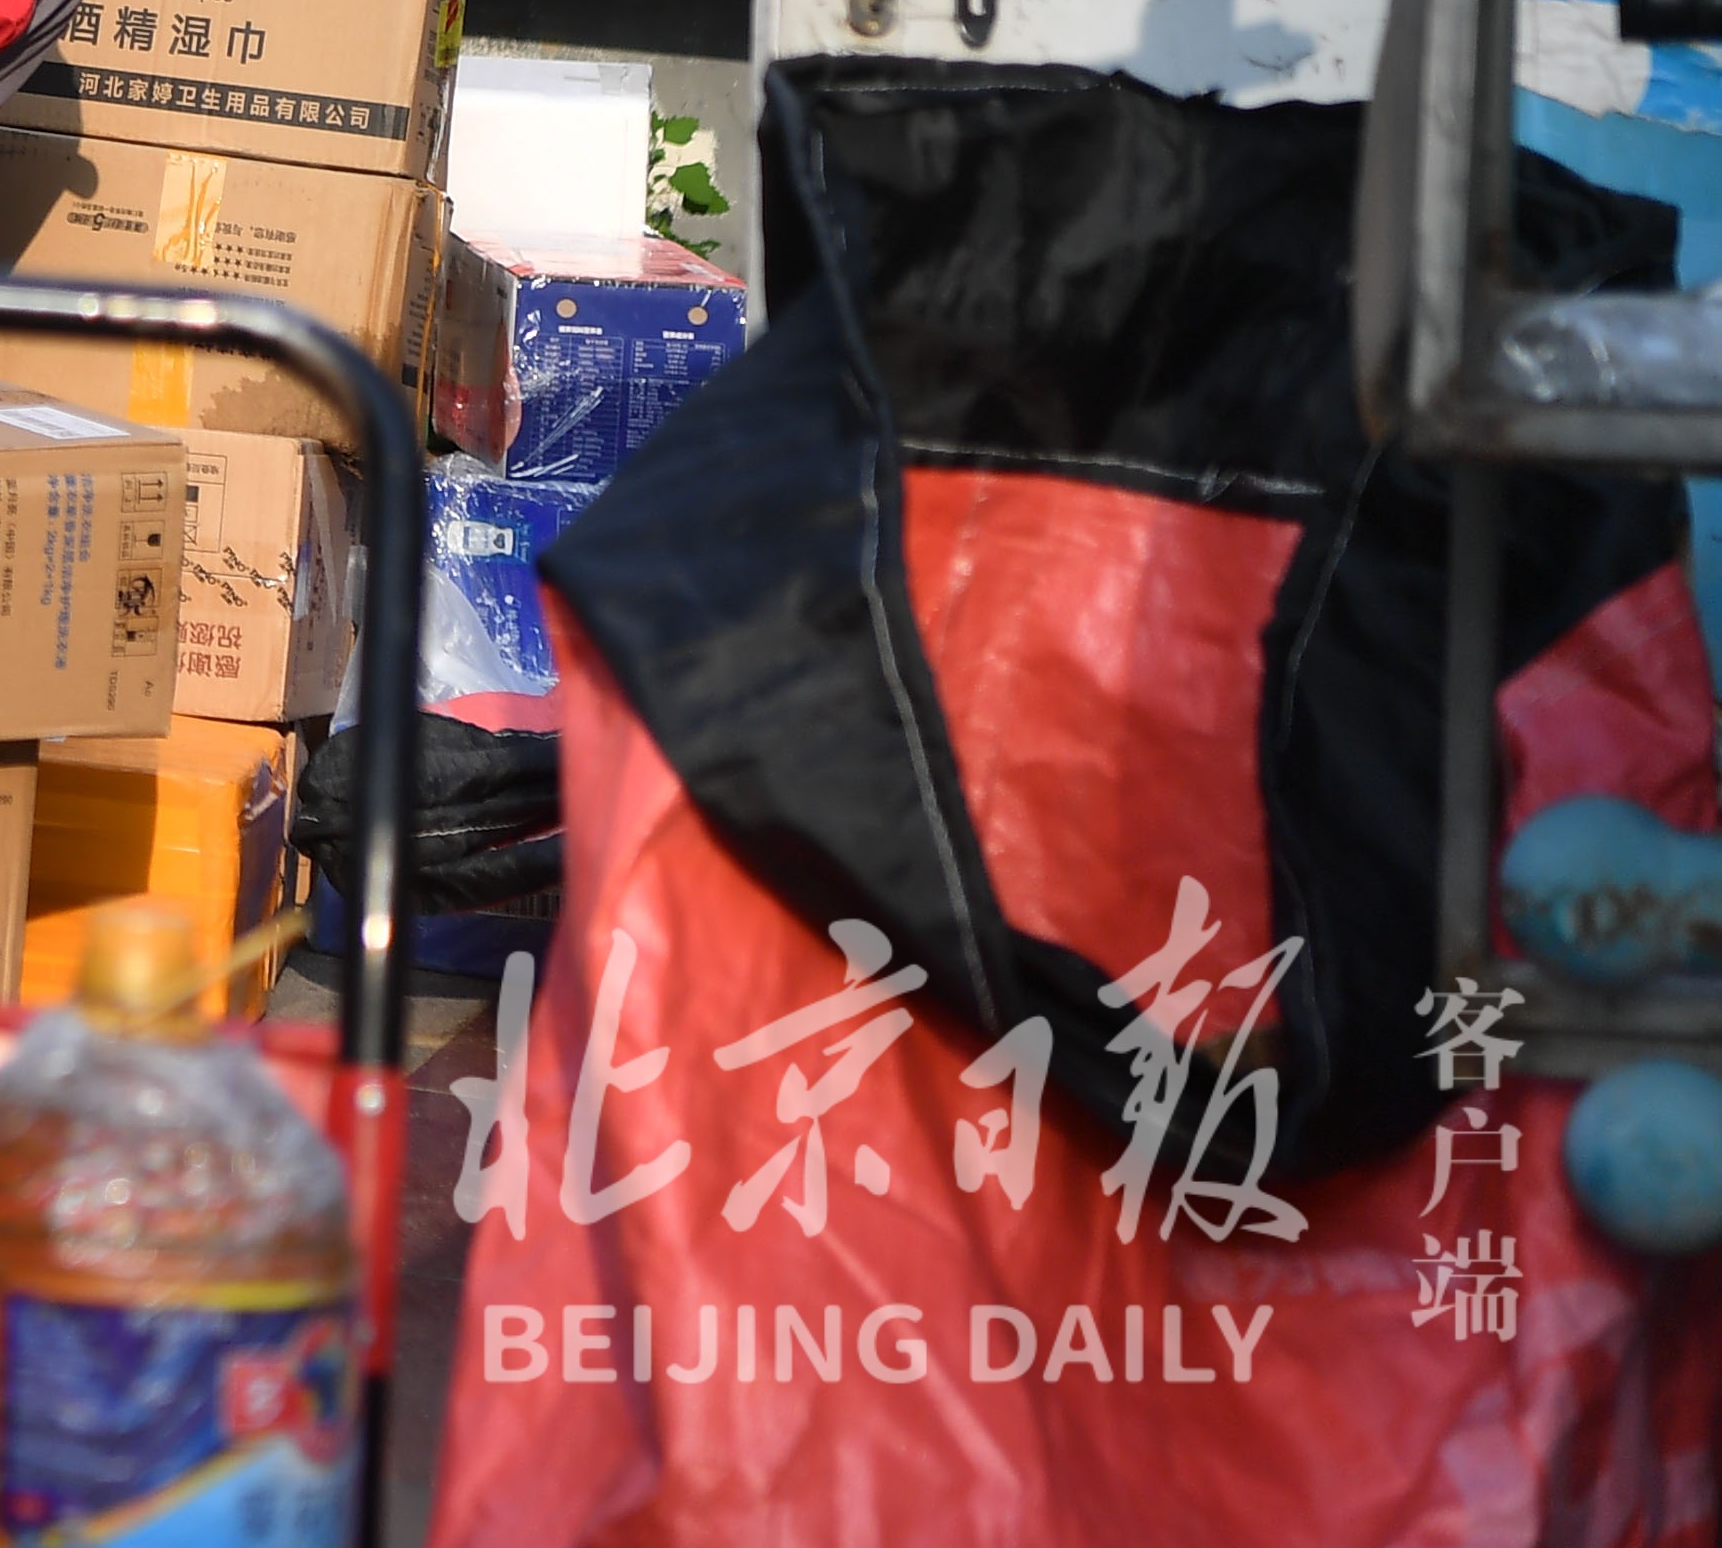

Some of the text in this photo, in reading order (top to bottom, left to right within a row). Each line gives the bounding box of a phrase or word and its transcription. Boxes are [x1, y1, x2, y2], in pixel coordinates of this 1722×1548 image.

[57, 3, 268, 65] 酒精湿巾
[78, 72, 371, 130] 河北家婷卫生用品有限公司
[176, 651, 242, 679] 感谢
